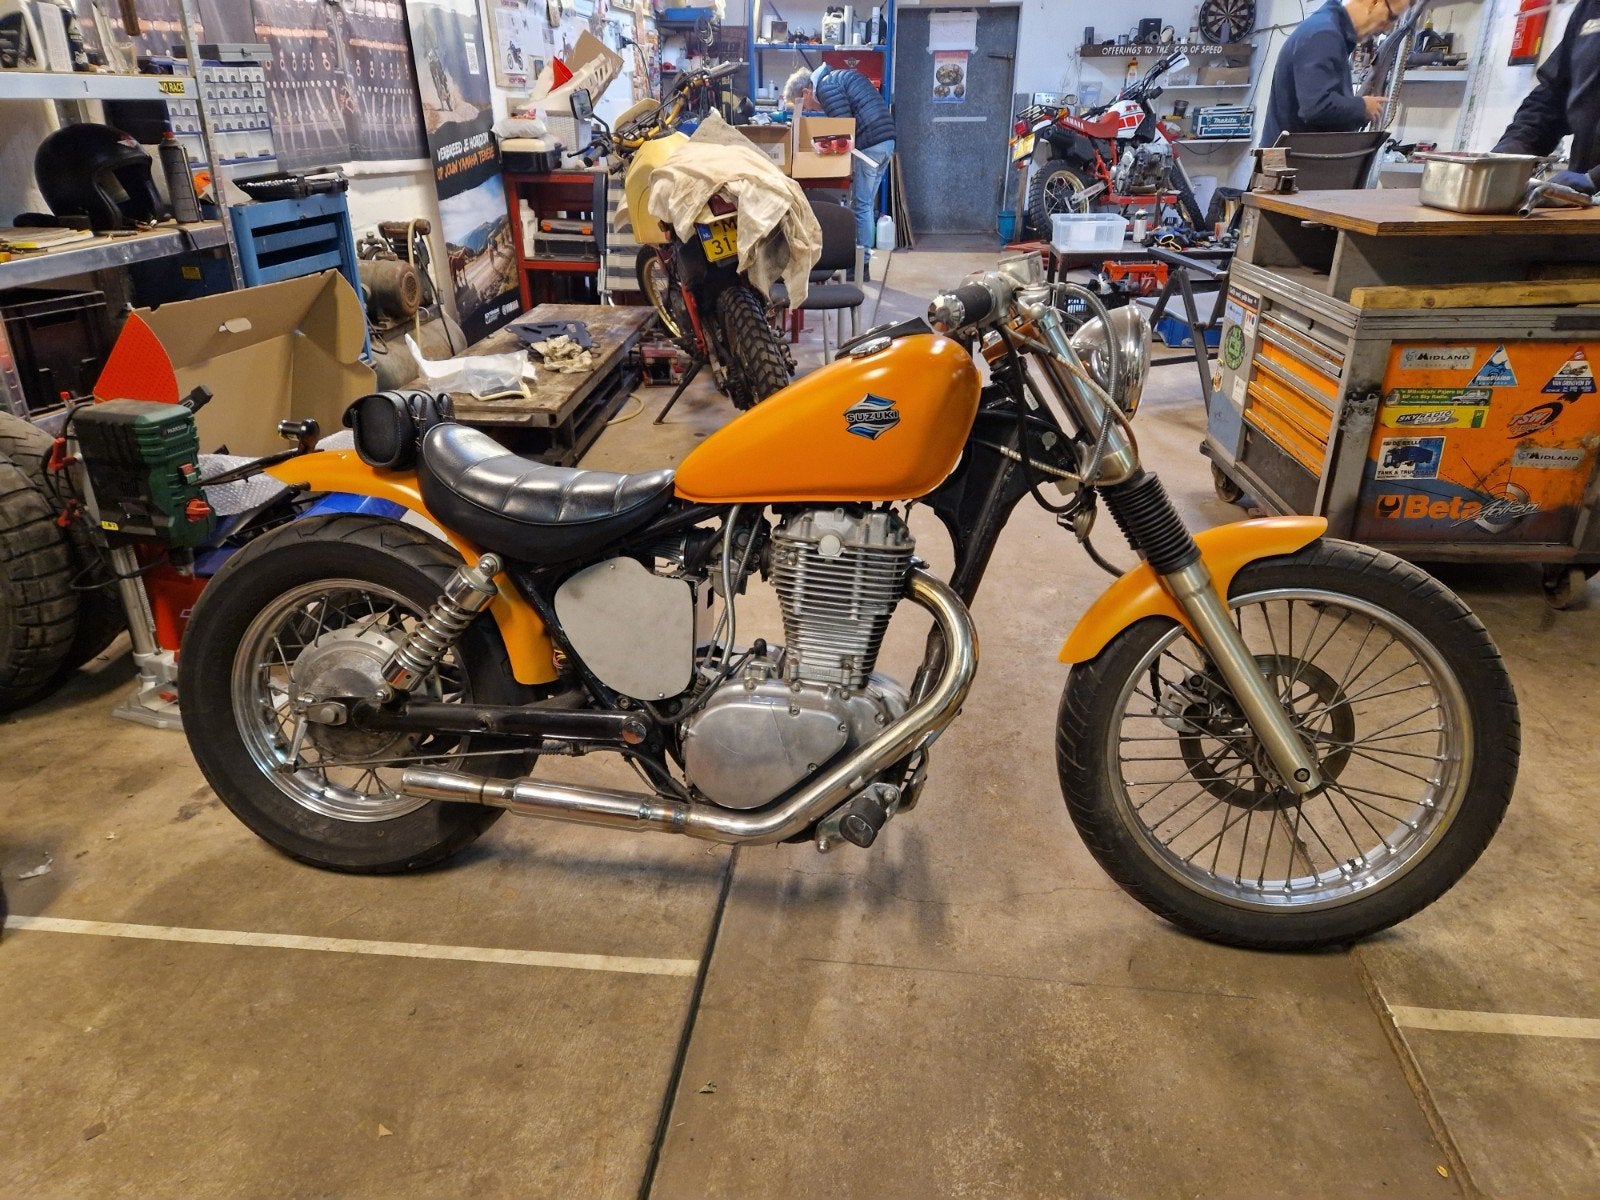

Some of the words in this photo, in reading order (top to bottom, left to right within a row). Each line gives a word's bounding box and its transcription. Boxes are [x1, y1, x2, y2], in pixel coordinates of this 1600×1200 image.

[1101, 45, 1141, 55] OFFERINGS
[1144, 45, 1152, 54] TO
[1156, 45, 1168, 54] THE
[1174, 45, 1188, 54] GOD
[1190, 45, 1200, 54] OF
[1201, 45, 1223, 54] SPEED
[169, 82, 184, 93] RACE
[436, 141, 463, 161] VERBREED
[847, 410, 898, 422] SUZUKI
[1528, 452, 1579, 460] MIDLAND
[1404, 495, 1482, 520] Beta
